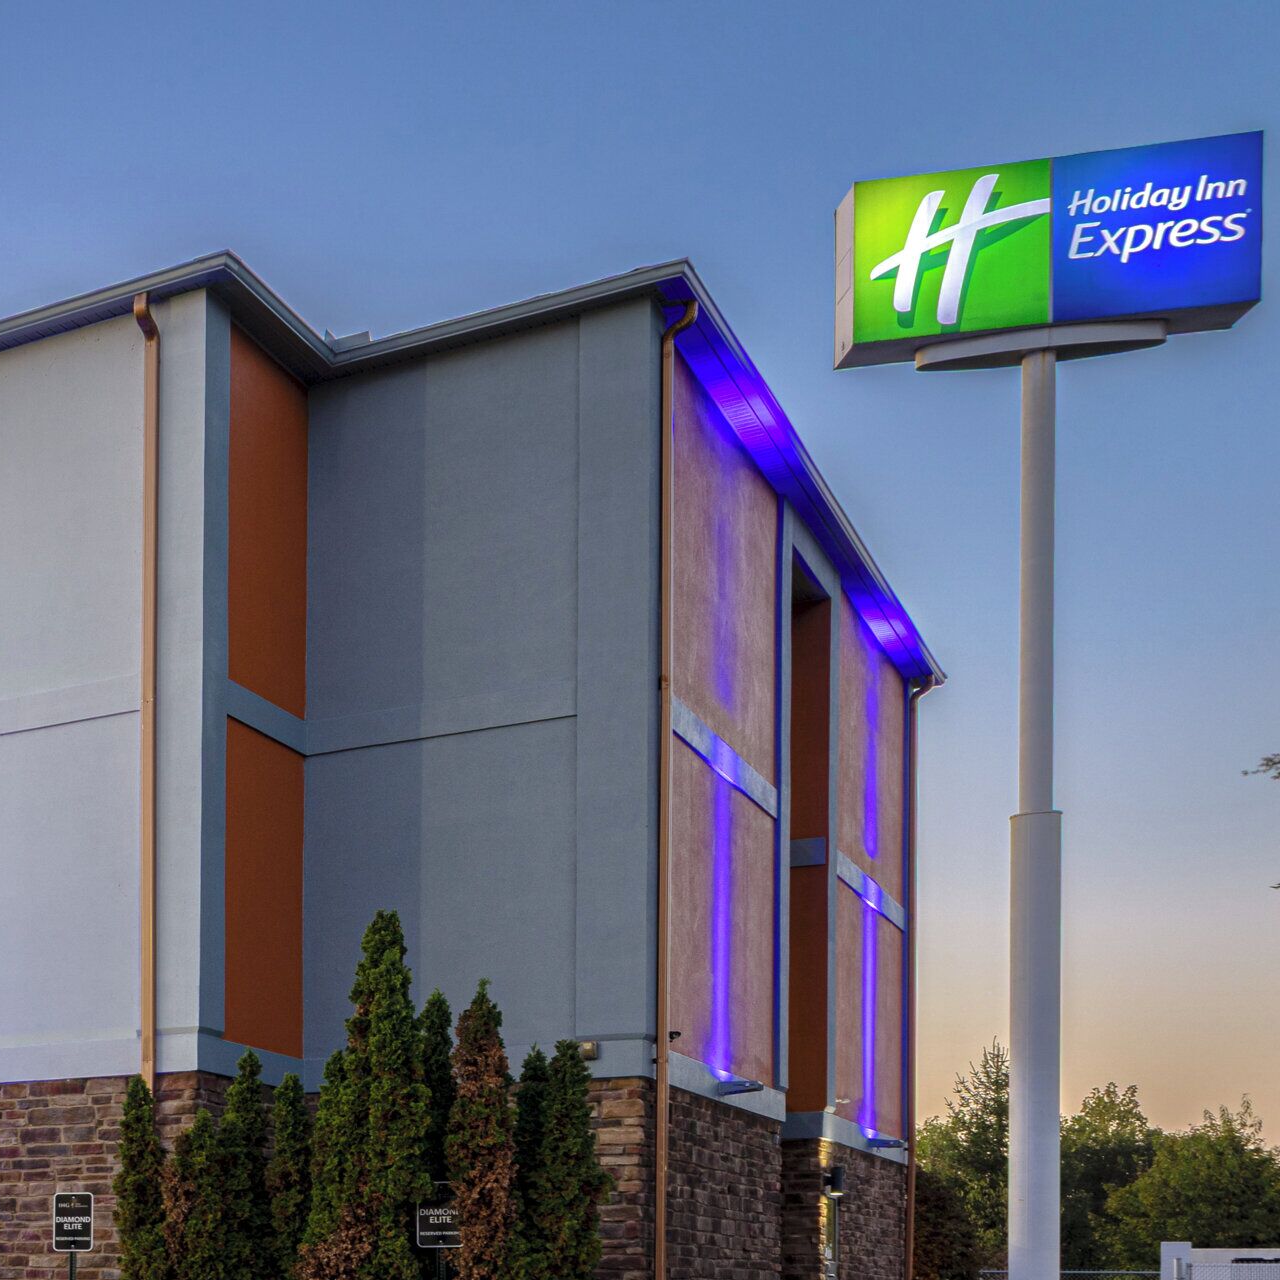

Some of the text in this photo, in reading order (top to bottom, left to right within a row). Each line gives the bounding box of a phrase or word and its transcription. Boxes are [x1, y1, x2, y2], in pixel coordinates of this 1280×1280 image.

[1067, 174, 1247, 216] Holiday Inn
[1067, 212, 1247, 264] Express
[429, 1216, 453, 1224] ELITE
